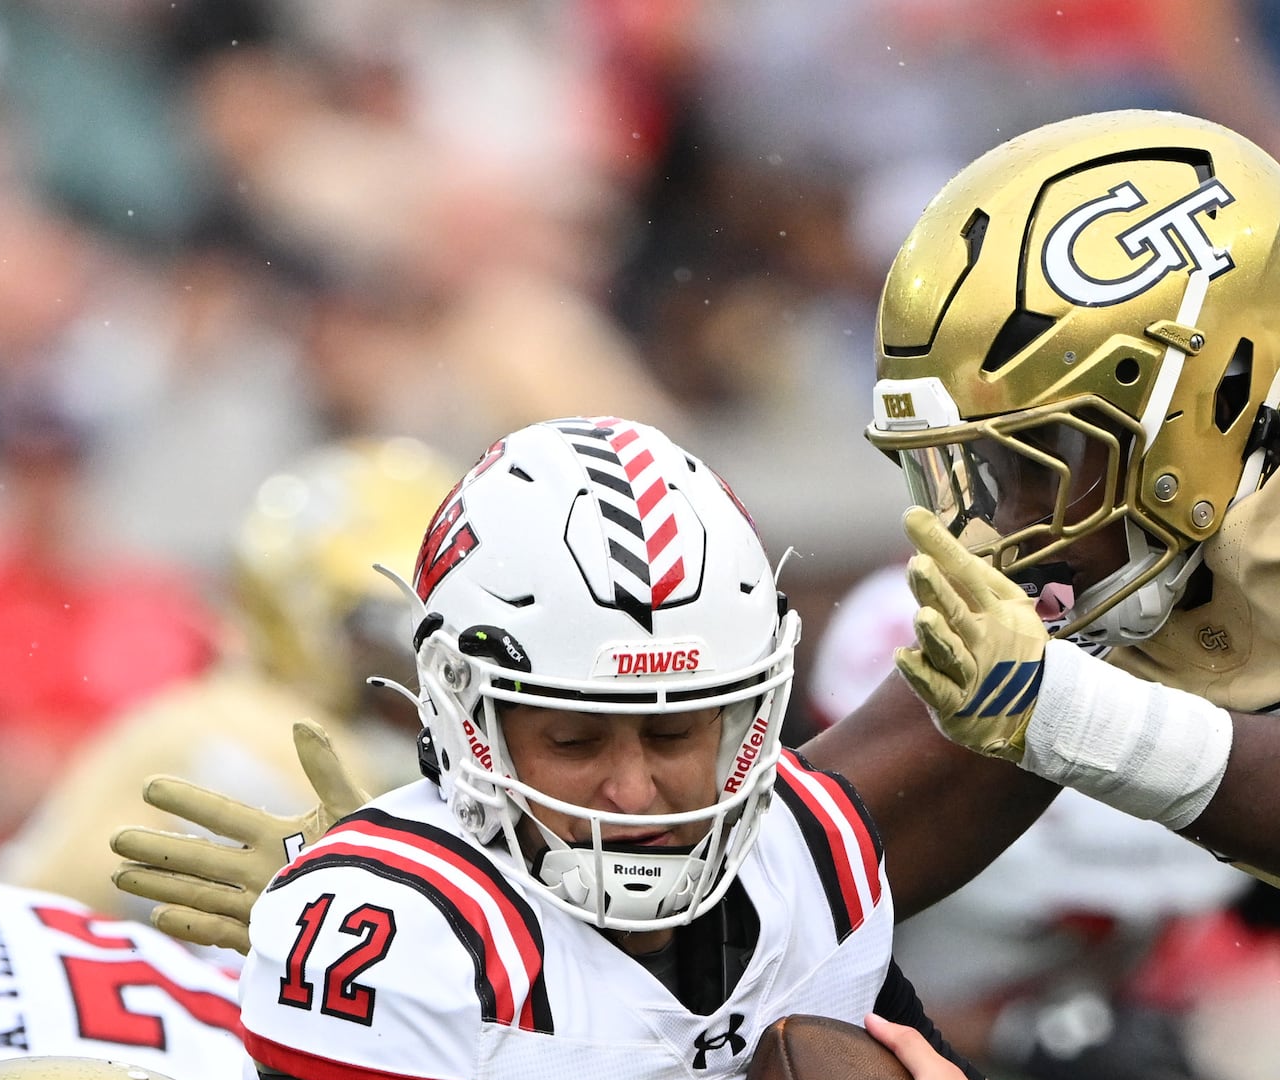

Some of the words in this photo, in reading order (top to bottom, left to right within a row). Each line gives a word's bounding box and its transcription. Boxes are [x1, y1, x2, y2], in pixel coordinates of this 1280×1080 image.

[1041, 178, 1236, 307] GT
[882, 392, 916, 418] TECH
[502, 635, 524, 662] SHOCK
[1198, 626, 1229, 651] GT
[724, 717, 769, 794] Riddell
[613, 864, 662, 877] Riddell
[278, 892, 396, 1026] 12
